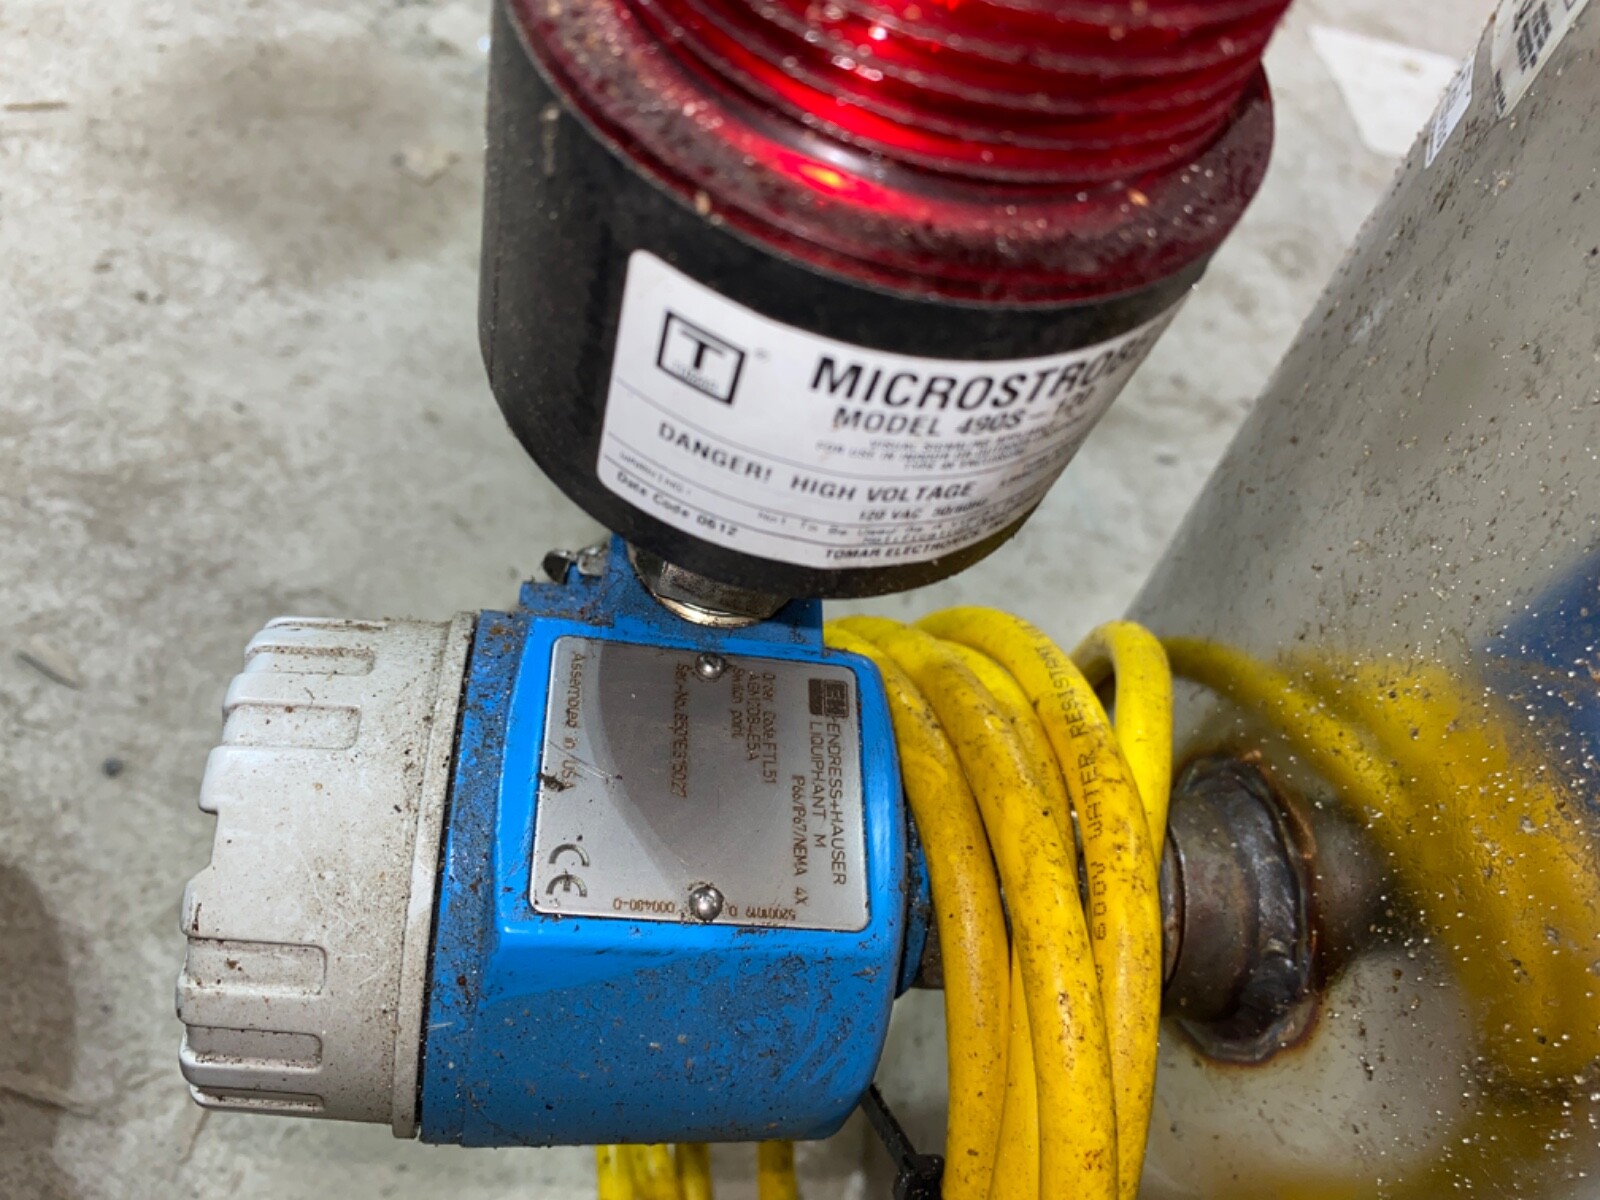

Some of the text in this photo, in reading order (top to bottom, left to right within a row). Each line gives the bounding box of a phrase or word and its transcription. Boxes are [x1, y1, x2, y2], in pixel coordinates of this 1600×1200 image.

[831, 405, 941, 437] MODEL
[616, 471, 649, 497] Date
[652, 492, 690, 519] Code
[658, 421, 773, 484] DANGER!
[789, 474, 857, 500] HIGH
[866, 480, 978, 503] VOLTAGE
[825, 547, 881, 560] TOMAR
[859, 508, 885, 521] 120
[891, 508, 923, 520] VAC
[561, 651, 587, 790] Assembled in USA
[810, 721, 827, 849] LIQUIPHANT M
[827, 721, 847, 885] ENDRESS+HAUSER
[1077, 749, 1105, 841] WATER
[795, 886, 809, 906] 4X
[1090, 860, 1108, 941] 600V
